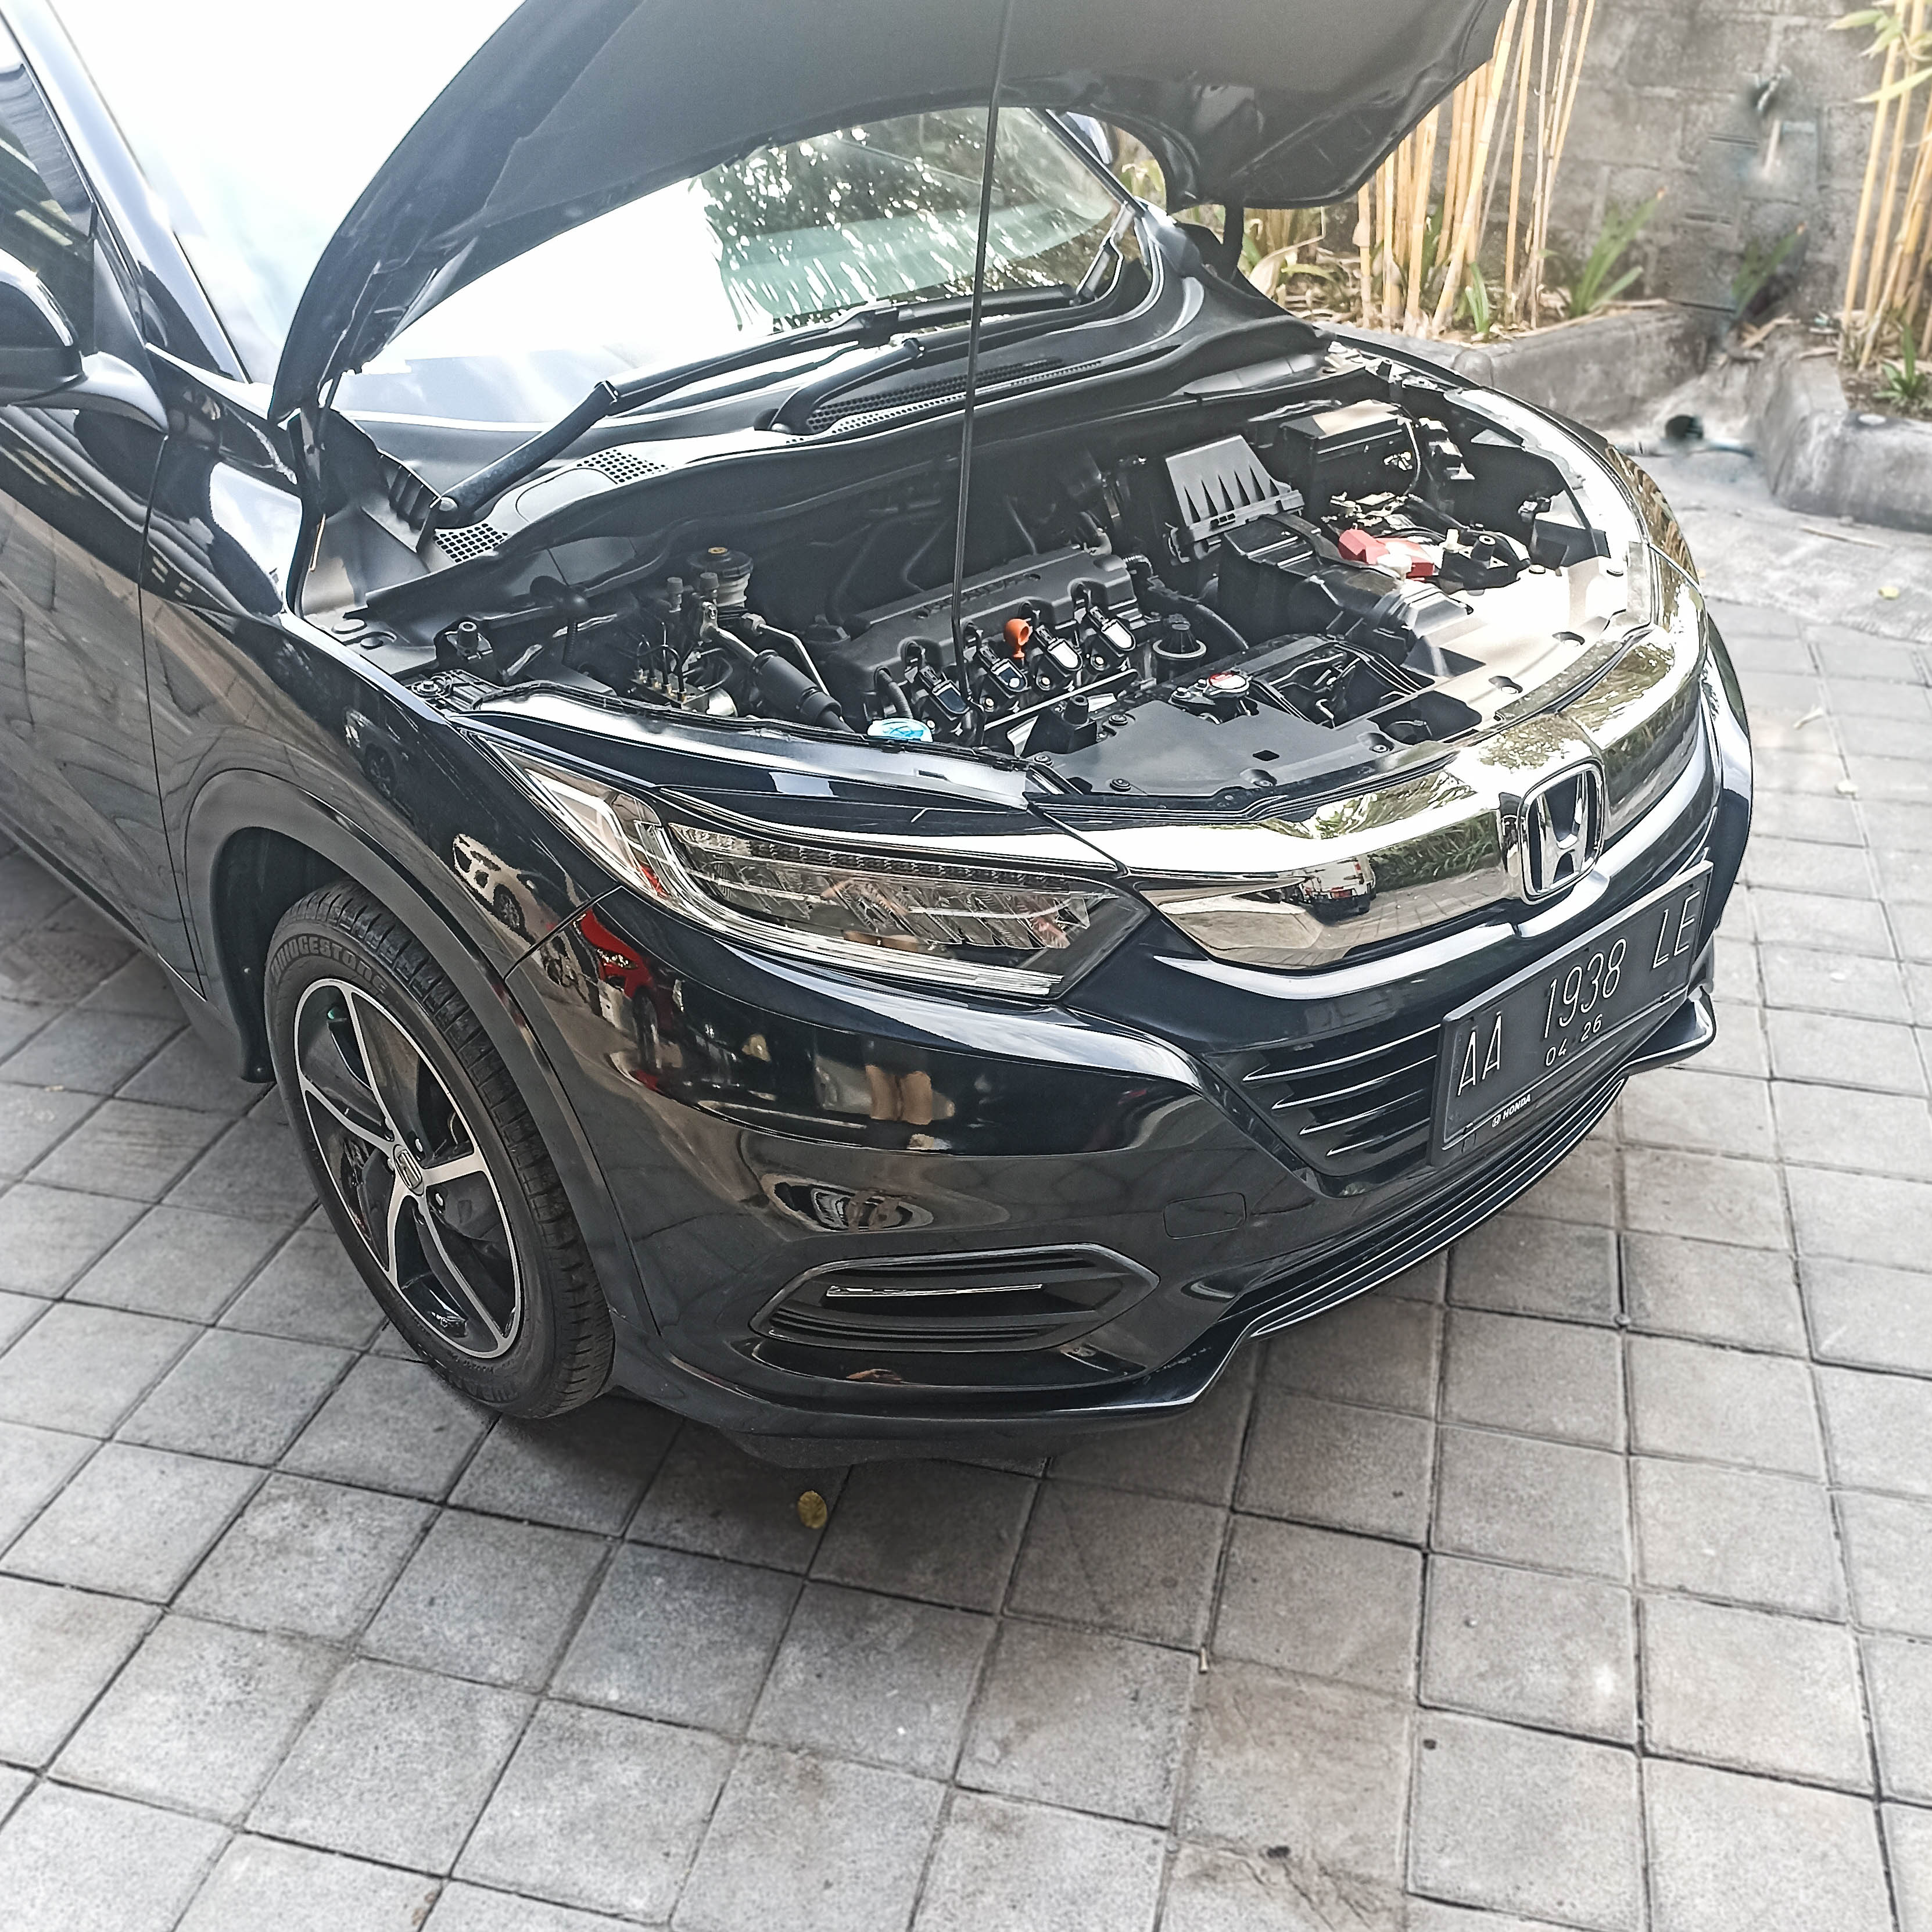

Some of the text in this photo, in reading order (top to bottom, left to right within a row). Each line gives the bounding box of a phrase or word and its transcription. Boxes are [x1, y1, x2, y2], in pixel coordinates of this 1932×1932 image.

[270, 935, 388, 995] BRIDGESTONE
[1457, 890, 1701, 1096] AA 1938 LE
[1545, 1013, 1603, 1067] 04 26
[1502, 1094, 1531, 1120] HONDA
